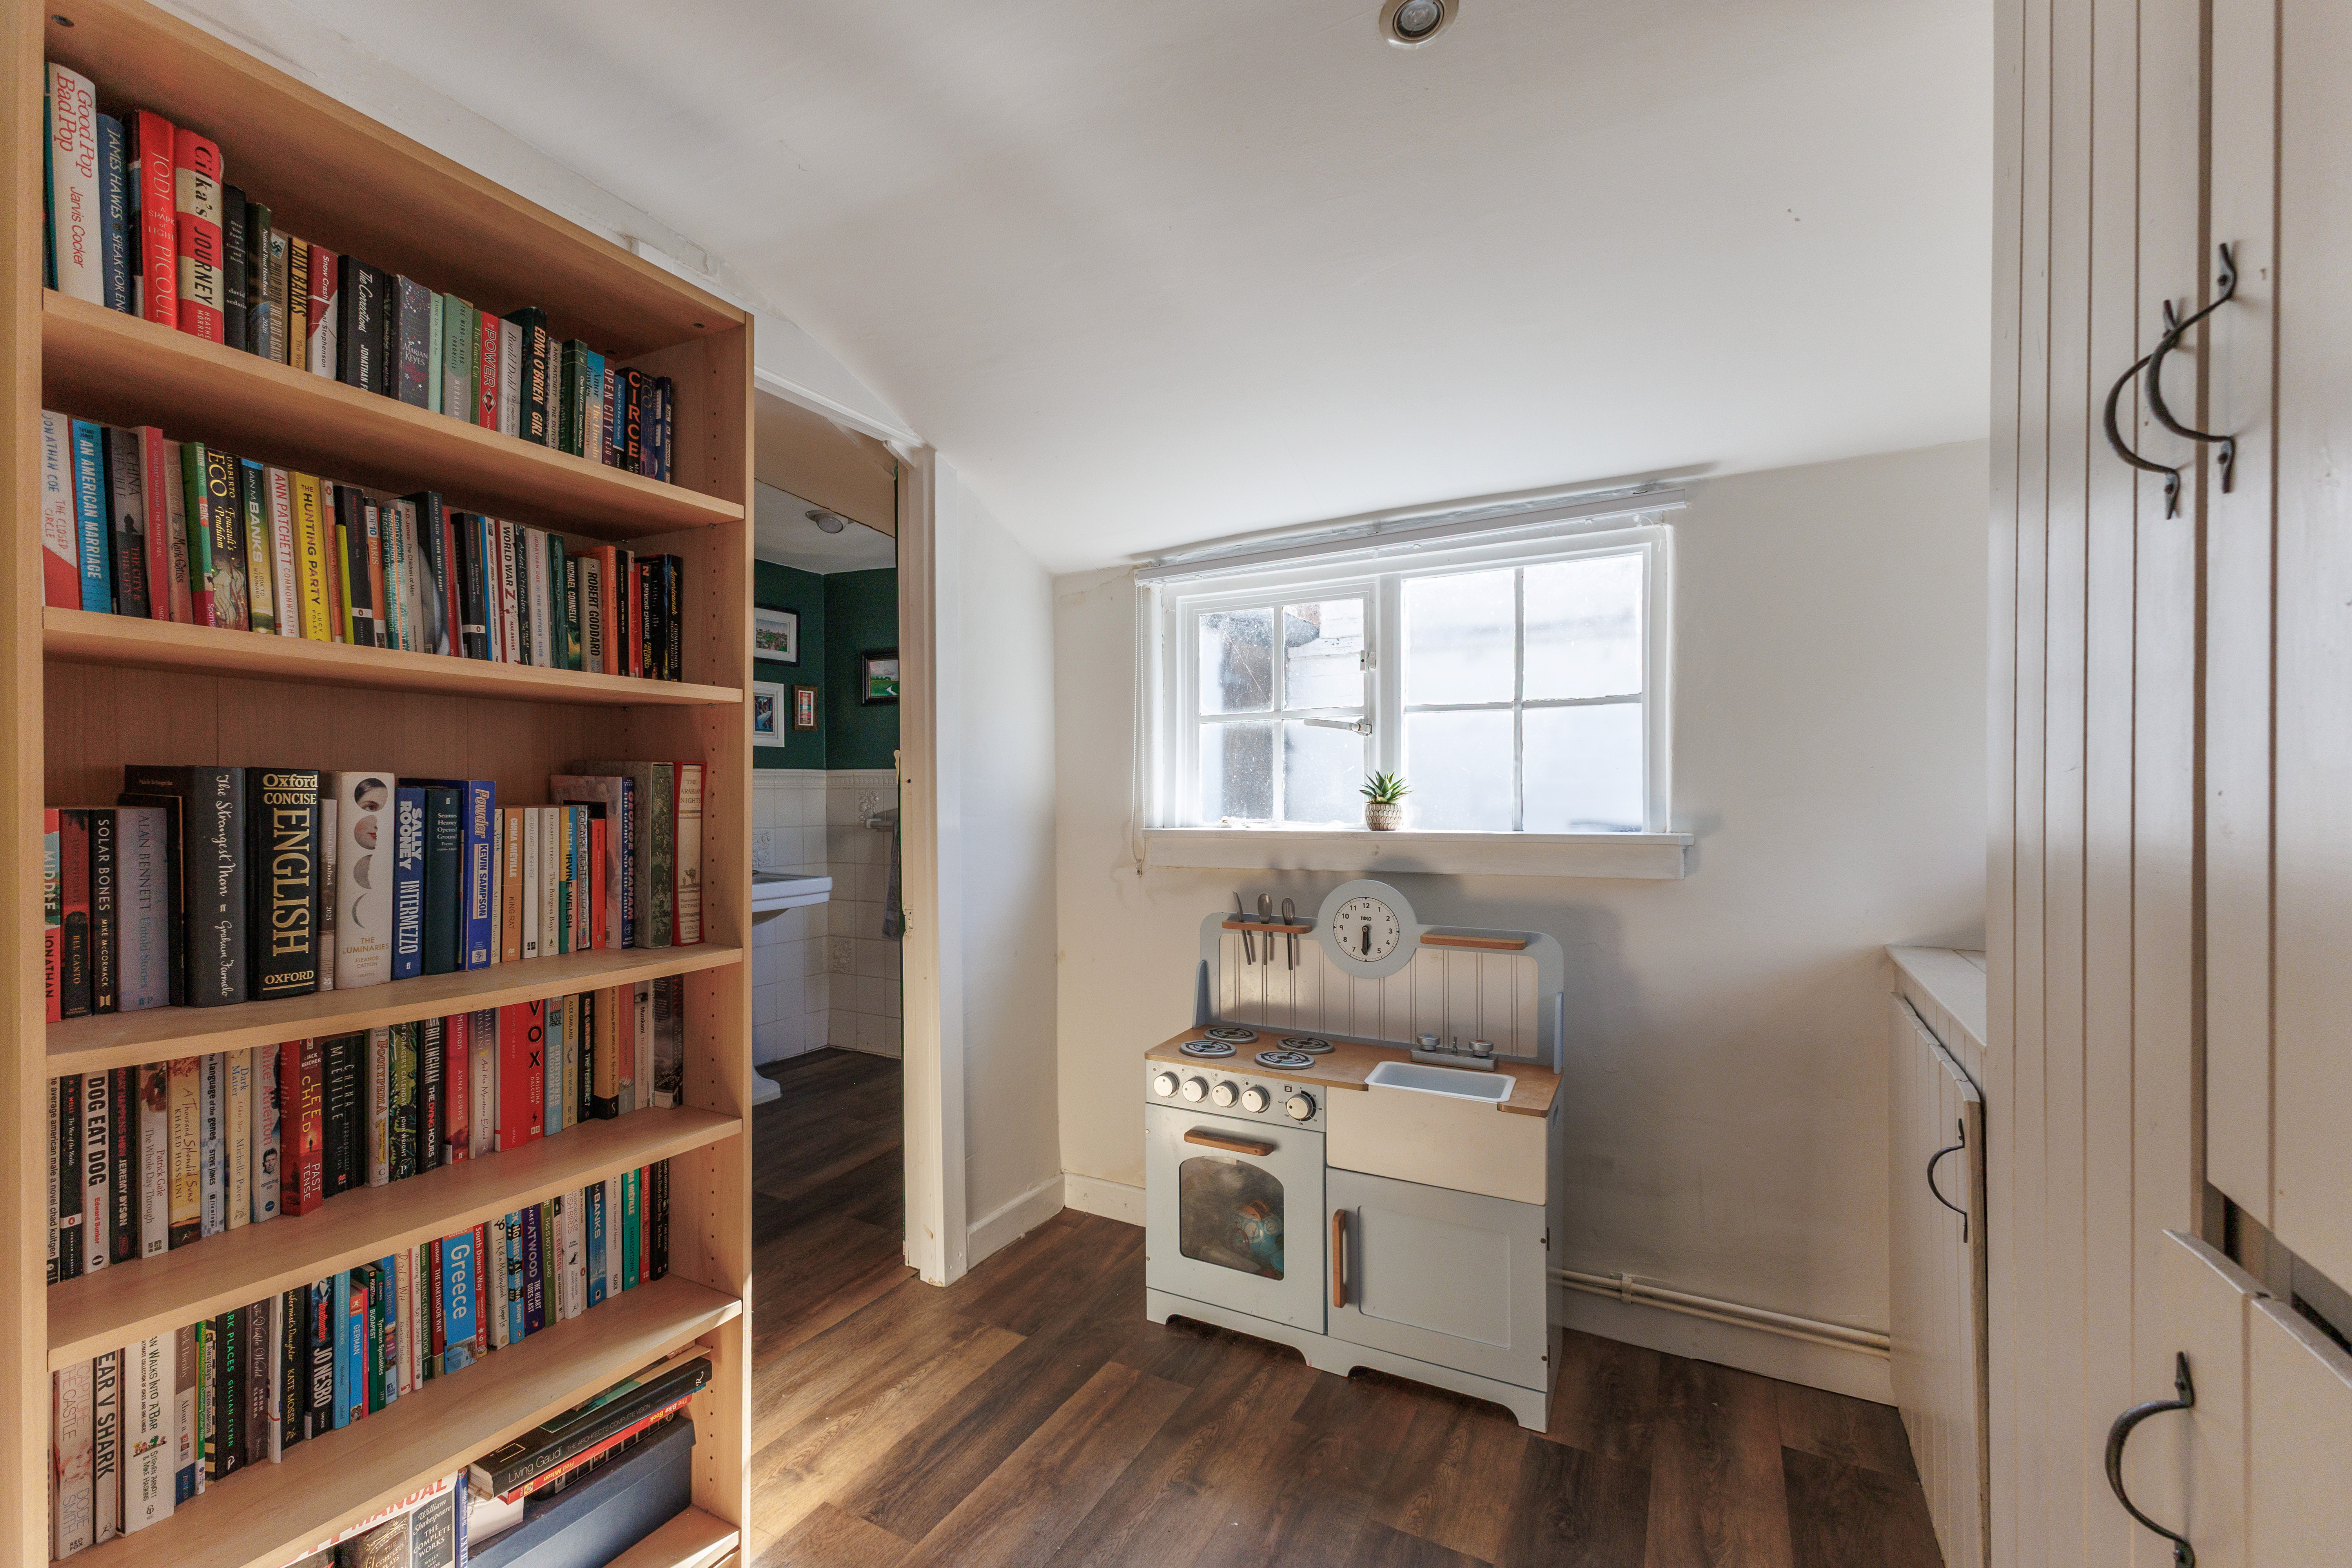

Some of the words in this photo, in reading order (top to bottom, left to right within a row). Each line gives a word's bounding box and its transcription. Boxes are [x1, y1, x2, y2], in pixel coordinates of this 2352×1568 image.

[58, 73, 76, 119] Bad
[77, 89, 94, 141] Good
[54, 117, 77, 152] Pop
[107, 127, 122, 169] JAMES
[76, 140, 94, 178] Pop
[151, 151, 171, 200] JODI
[110, 171, 122, 224] HAWES
[195, 146, 212, 218] Cilka's
[71, 187, 83, 223] Jarvis
[72, 226, 85, 268] Cocker
[194, 227, 212, 305] JOURNEY
[292, 245, 307, 274] IAIN
[292, 276, 307, 317] BANKS
[403, 343, 428, 360] MARIAN
[405, 352, 425, 366] KEYES
[484, 328, 496, 387] POWER
[534, 326, 545, 358] EDNA
[360, 344, 368, 381] JONATHAN
[533, 359, 544, 405] O'BRIEN
[604, 369, 614, 400] OPEN
[532, 412, 543, 436] GIRL
[604, 405, 613, 432] CITY
[628, 372, 641, 458] CIRCE
[80, 440, 93, 456] AN
[80, 459, 98, 517] AMERICAN
[208, 451, 227, 497] ECO
[227, 456, 236, 498] UMBERTO
[275, 474, 287, 499] ANN
[301, 484, 313, 493] THE
[215, 505, 224, 548] Pendulum
[225, 508, 236, 551] Foucault's
[277, 503, 292, 566] PATCHETT
[302, 493, 318, 556] HUNTING
[503, 526, 511, 561] WORLD
[84, 520, 101, 579] MARRIAGE
[308, 559, 320, 605] PARTY
[504, 564, 512, 587] WAR
[505, 588, 515, 600] Z
[587, 572, 598, 607] ROBERT
[283, 568, 294, 635] COMMONWEALTH
[567, 591, 577, 623] CONNELLY
[590, 609, 601, 656] GODDARD
[216, 775, 229, 797] The
[263, 773, 318, 788] Oxford
[264, 793, 317, 805] CONCISE
[138, 814, 149, 848] ALAN
[215, 800, 234, 862] Strangest
[474, 789, 490, 838] Powder
[510, 818, 518, 842] CHINA
[98, 819, 109, 862] SOLAR
[400, 801, 412, 870] ROONEY
[411, 808, 422, 860] SALLY
[98, 868, 109, 911] BONES
[139, 853, 151, 911] BENNETT
[218, 862, 236, 896] Man
[273, 808, 310, 956] ENGLISH
[478, 872, 487, 918] SAMPSON
[399, 880, 420, 954] INTERMEZZO
[342, 943, 389, 954] LUMINARIES
[265, 969, 314, 985] OXFORD
[528, 1000, 542, 1069] VOX
[425, 1027, 440, 1083] BILLINGHAM
[88, 1077, 106, 1112] DOG
[376, 1040, 387, 1115] FOOTYPEDIA
[301, 1076, 310, 1132] CHILD
[311, 1082, 321, 1118] LEE
[88, 1116, 106, 1145] EAT
[89, 1150, 107, 1186] DOG
[312, 1163, 320, 1191] PAST
[528, 1226, 537, 1278] ATWOOD
[451, 1243, 470, 1319] Greece
[314, 1347, 333, 1364] JO
[98, 1396, 116, 1407] V
[650, 1410, 663, 1421] Book
[665, 1403, 677, 1413] Bike
[97, 1412, 115, 1480] SHARK
[508, 1463, 534, 1483] Living
[536, 1446, 562, 1468] Gaudí
[567, 1440, 577, 1451] THE
[610, 1413, 635, 1430] COMPLETE
[635, 1404, 651, 1415] VISION
[414, 1505, 451, 1534] Shakespeare
[418, 1499, 446, 1519] William
[413, 1525, 451, 1553] COMPLETE
[419, 1538, 445, 1557] WORKS
[424, 1524, 439, 1537] THE
